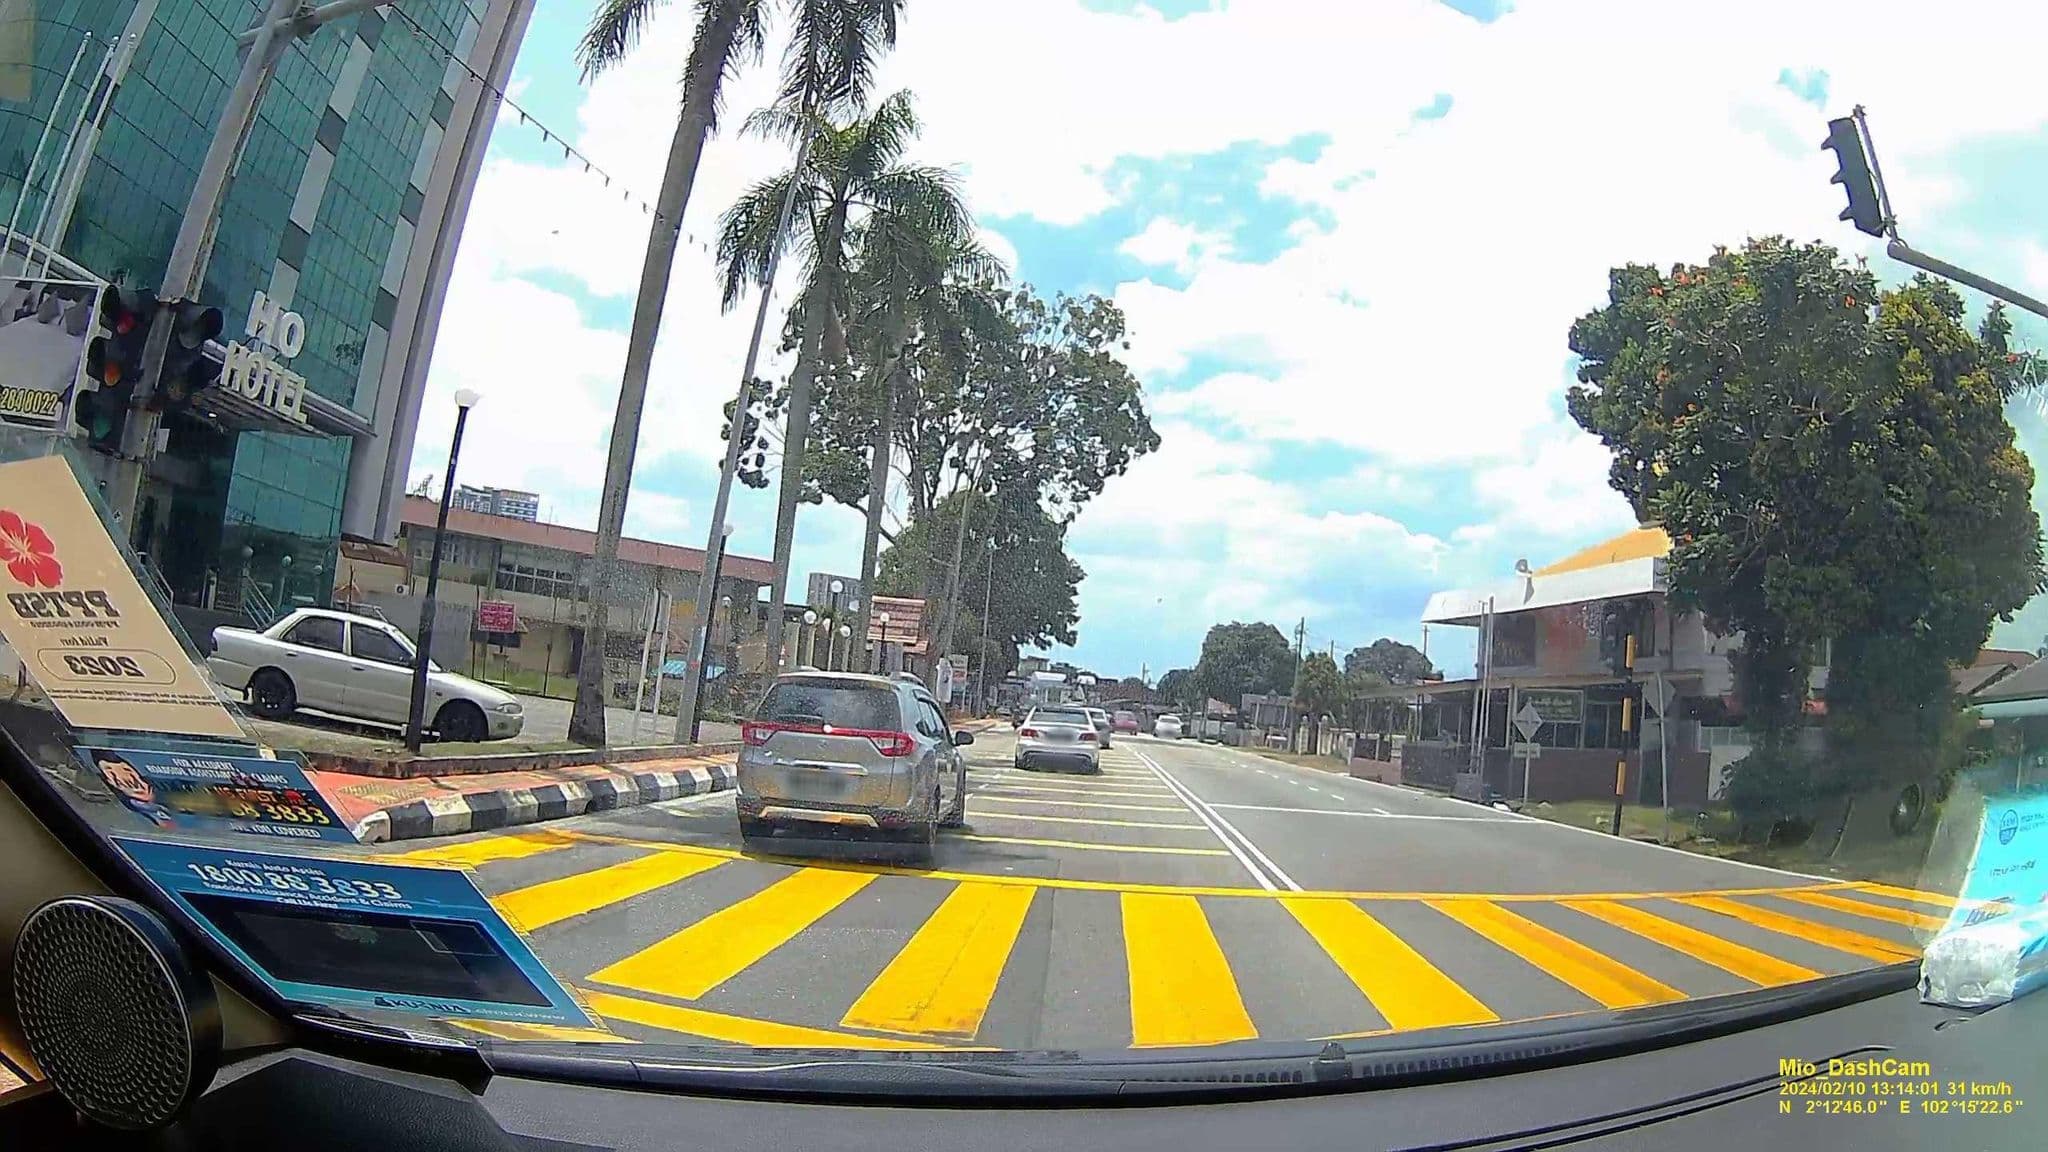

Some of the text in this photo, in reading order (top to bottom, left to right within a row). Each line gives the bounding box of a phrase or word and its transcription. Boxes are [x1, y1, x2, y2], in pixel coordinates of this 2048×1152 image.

[245, 290, 305, 359] HO
[220, 339, 308, 424] HOTEL
[145, 764, 189, 776] ROADSIDE
[250, 773, 288, 785] CLAIMS
[172, 758, 192, 768] FOR
[259, 802, 331, 826] 3833
[248, 823, 273, 835] YOU
[271, 825, 321, 840] COVERED
[187, 864, 403, 900] 1800 88 3833
[262, 863, 291, 873] Auto
[289, 866, 327, 877] Assist
[203, 882, 250, 894] Roadside
[308, 892, 360, 905] Accident
[369, 900, 414, 910] Claims
